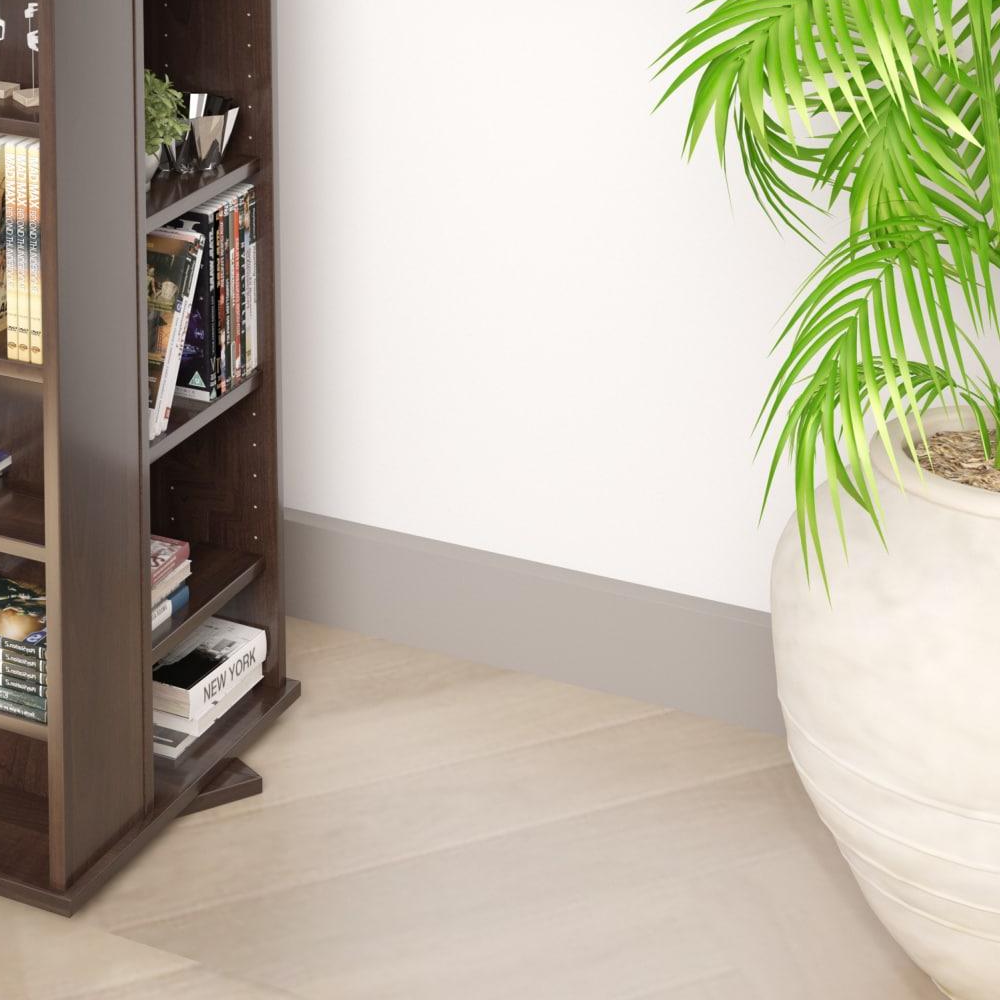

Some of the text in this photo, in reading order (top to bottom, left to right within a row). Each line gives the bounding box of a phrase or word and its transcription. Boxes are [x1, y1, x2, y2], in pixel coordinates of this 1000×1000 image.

[6, 152, 16, 178] MAD
[17, 154, 27, 180] MAD
[30, 156, 40, 182] MAD
[6, 180, 16, 206] MAX
[17, 182, 27, 207] MAX
[30, 183, 40, 209] MAX
[203, 648, 256, 704] NEW YORK
